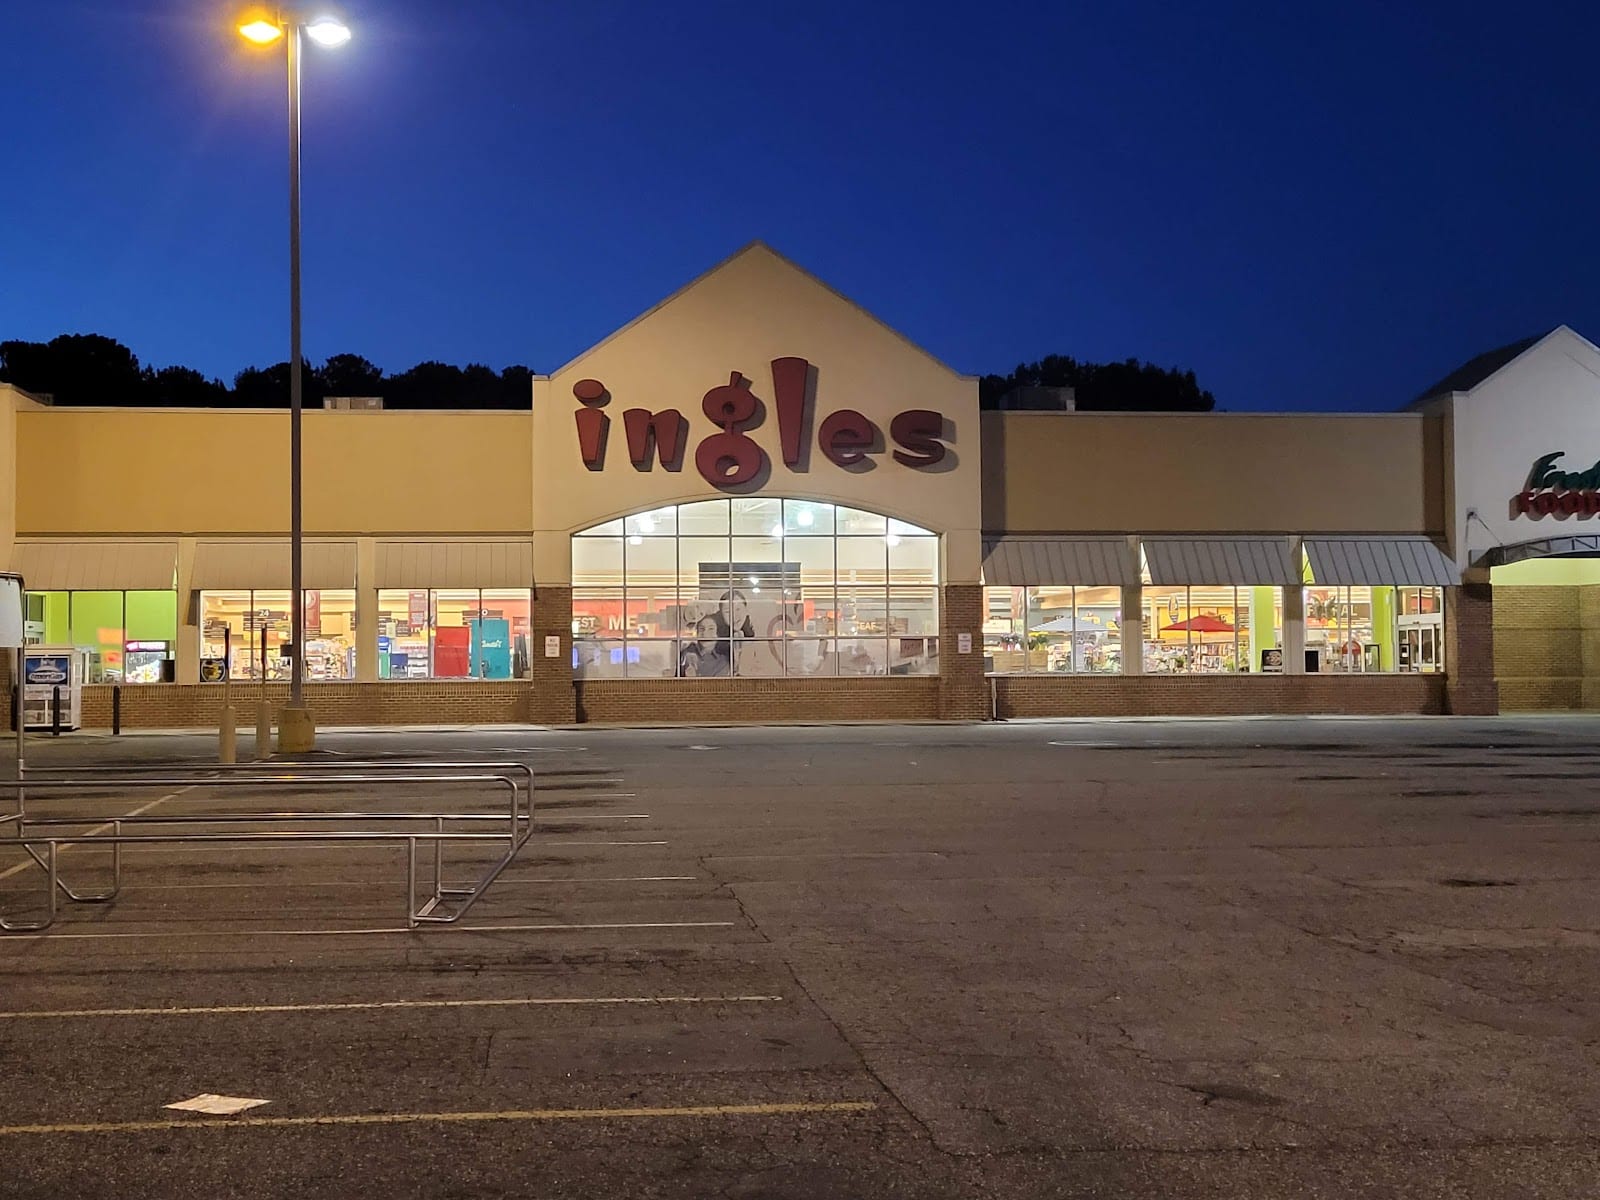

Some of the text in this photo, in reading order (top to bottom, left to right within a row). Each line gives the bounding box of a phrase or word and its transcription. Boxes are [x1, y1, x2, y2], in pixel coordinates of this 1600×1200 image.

[572, 356, 949, 488] ingles
[258, 608, 271, 617] 24
[1306, 604, 1358, 617] FAL
